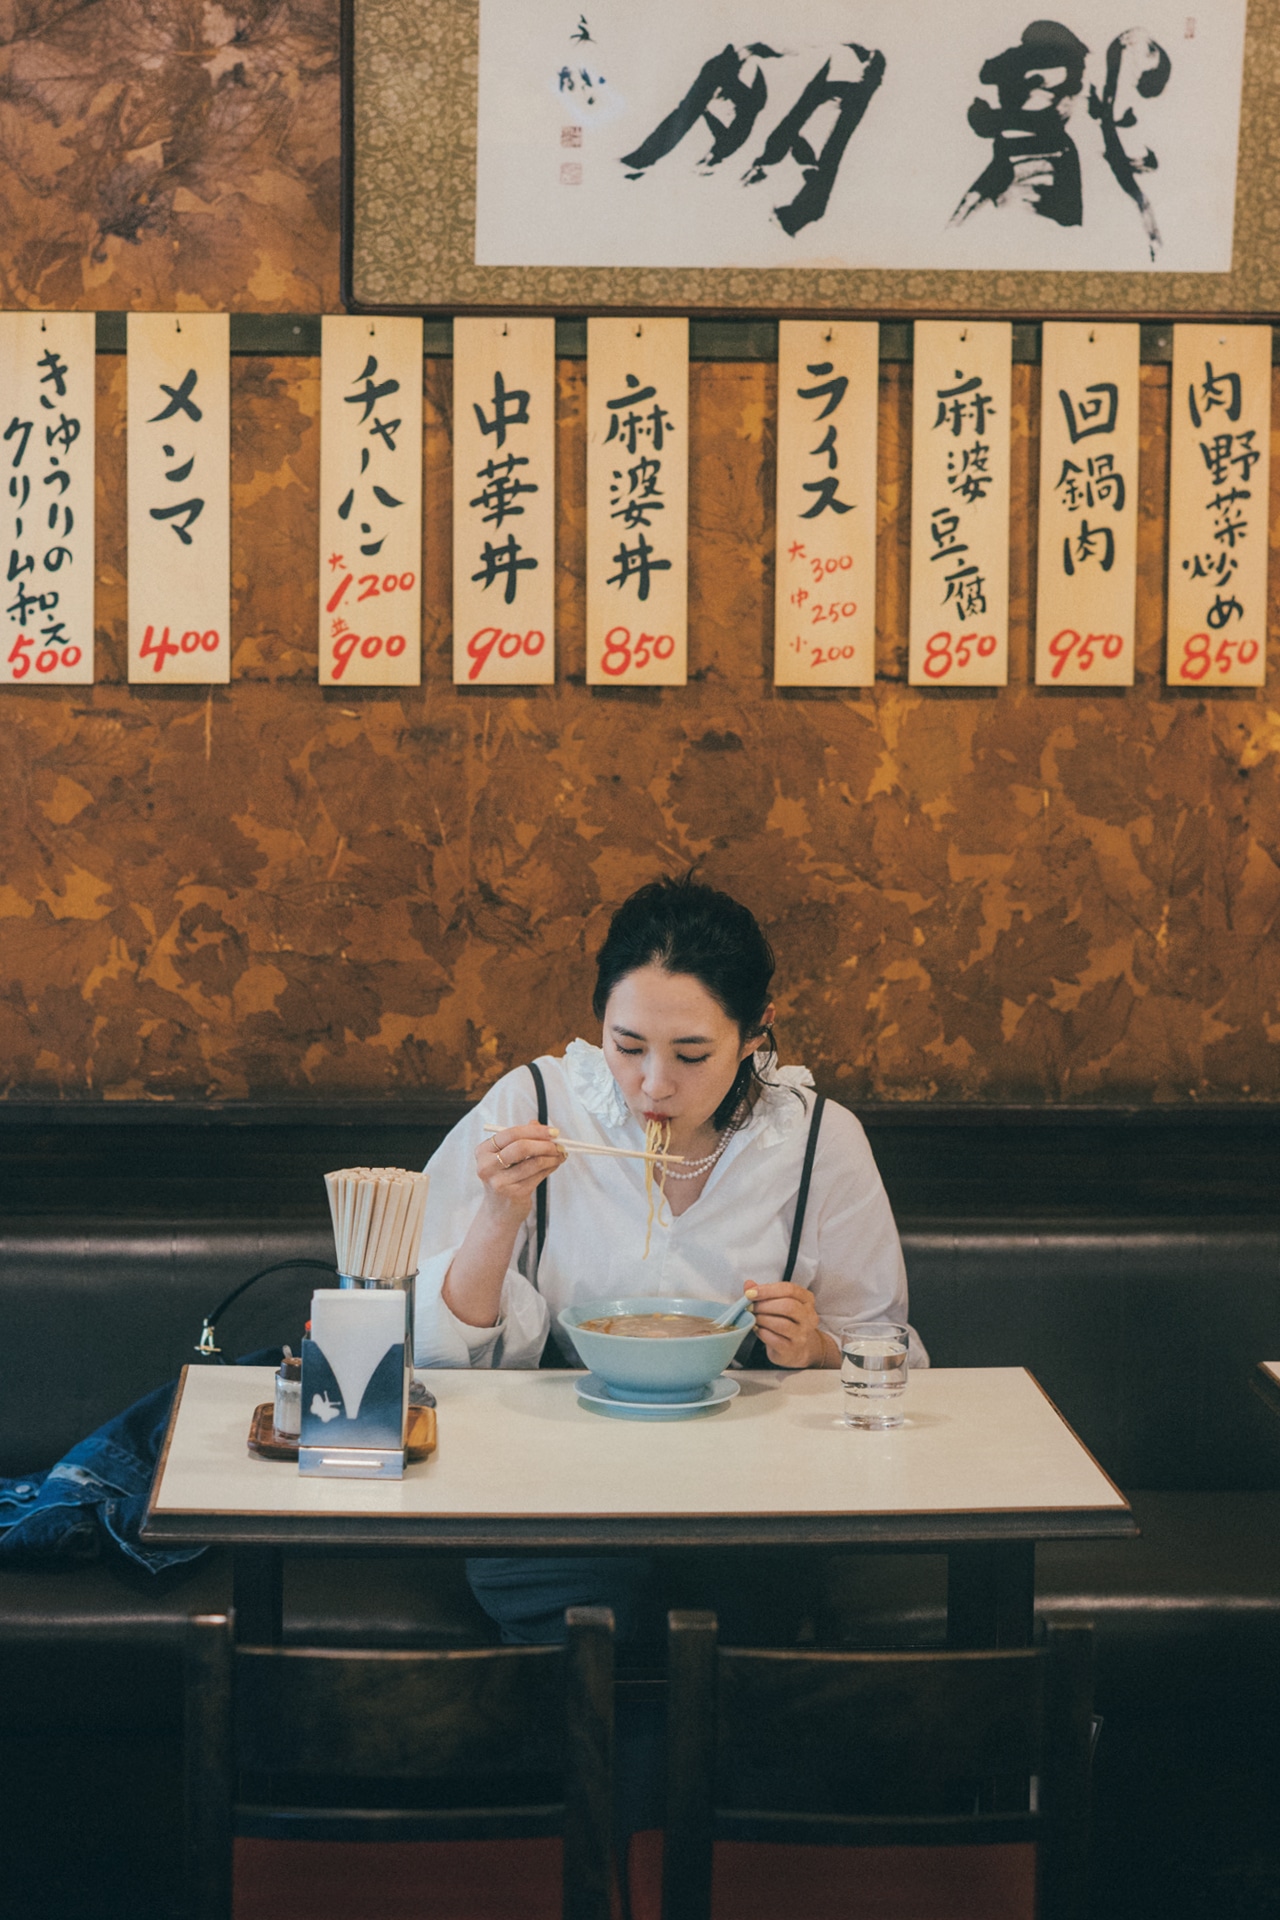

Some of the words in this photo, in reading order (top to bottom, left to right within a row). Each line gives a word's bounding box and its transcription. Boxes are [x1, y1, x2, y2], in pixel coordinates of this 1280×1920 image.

[146, 367, 205, 546] メンマ
[337, 354, 405, 557] チャーハン
[796, 361, 859, 519] ライス
[469, 370, 539, 605] 中華丼
[604, 373, 675, 602] 麻婆丼
[930, 368, 997, 622] 麻婆豆腐
[1054, 382, 1126, 577] 回鍋肉
[1182, 360, 1261, 630] 肉野菜炒め
[328, 552, 347, 572] 大
[787, 540, 806, 563] 大
[810, 555, 853, 583] 300
[789, 587, 809, 608] 中
[811, 601, 858, 625] 250
[7, 633, 83, 679] 500
[138, 625, 220, 673] 400
[331, 632, 407, 680] 900
[466, 626, 546, 681] 900
[600, 626, 676, 677] 850
[788, 636, 808, 653] 小
[810, 644, 856, 668] 200
[922, 631, 998, 679] 850
[1048, 628, 1125, 679] 950
[1179, 632, 1260, 681] 850
